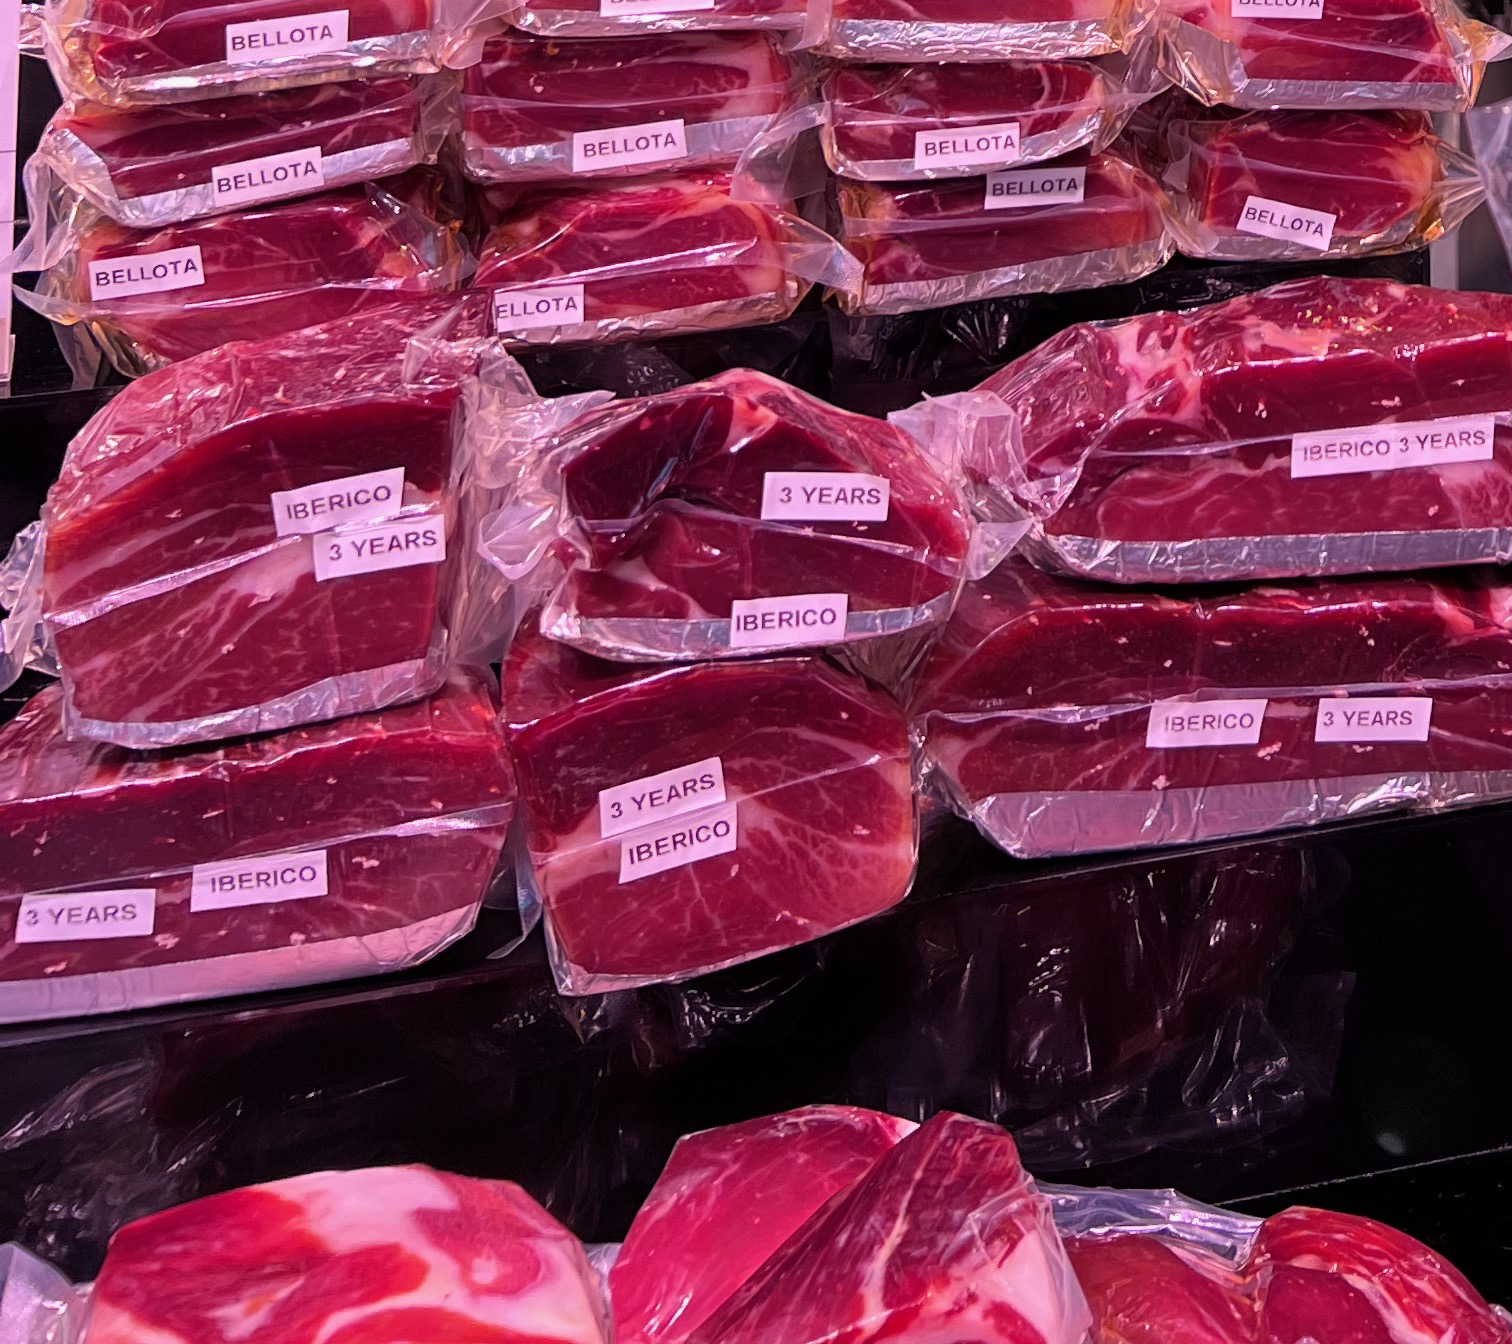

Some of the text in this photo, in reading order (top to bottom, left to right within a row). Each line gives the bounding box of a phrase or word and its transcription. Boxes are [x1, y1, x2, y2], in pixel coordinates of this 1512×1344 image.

[231, 23, 333, 52] BELLOTA
[582, 132, 678, 160] BELLOTA
[923, 134, 1017, 158] BELLOTA
[216, 158, 318, 195] BELLOTA
[991, 175, 1079, 197] BELLOTA
[1243, 206, 1326, 239] BELLOTA
[94, 257, 198, 288] BELLOTA
[497, 294, 579, 319] ELLOTA
[1302, 428, 1486, 463] IBERICO 3 YEARS
[285, 483, 392, 521] IBERICO
[779, 485, 882, 506] 3 YEARS
[329, 527, 438, 562] 3 YEARS
[735, 607, 838, 632] IBERICO
[1163, 709, 1413, 734] IBERICO 3 YEARS
[610, 774, 716, 820] 3 YEARS
[628, 820, 732, 866] IBERICO
[210, 864, 318, 894] IBERICO
[25, 902, 138, 926] 3 YEARS
